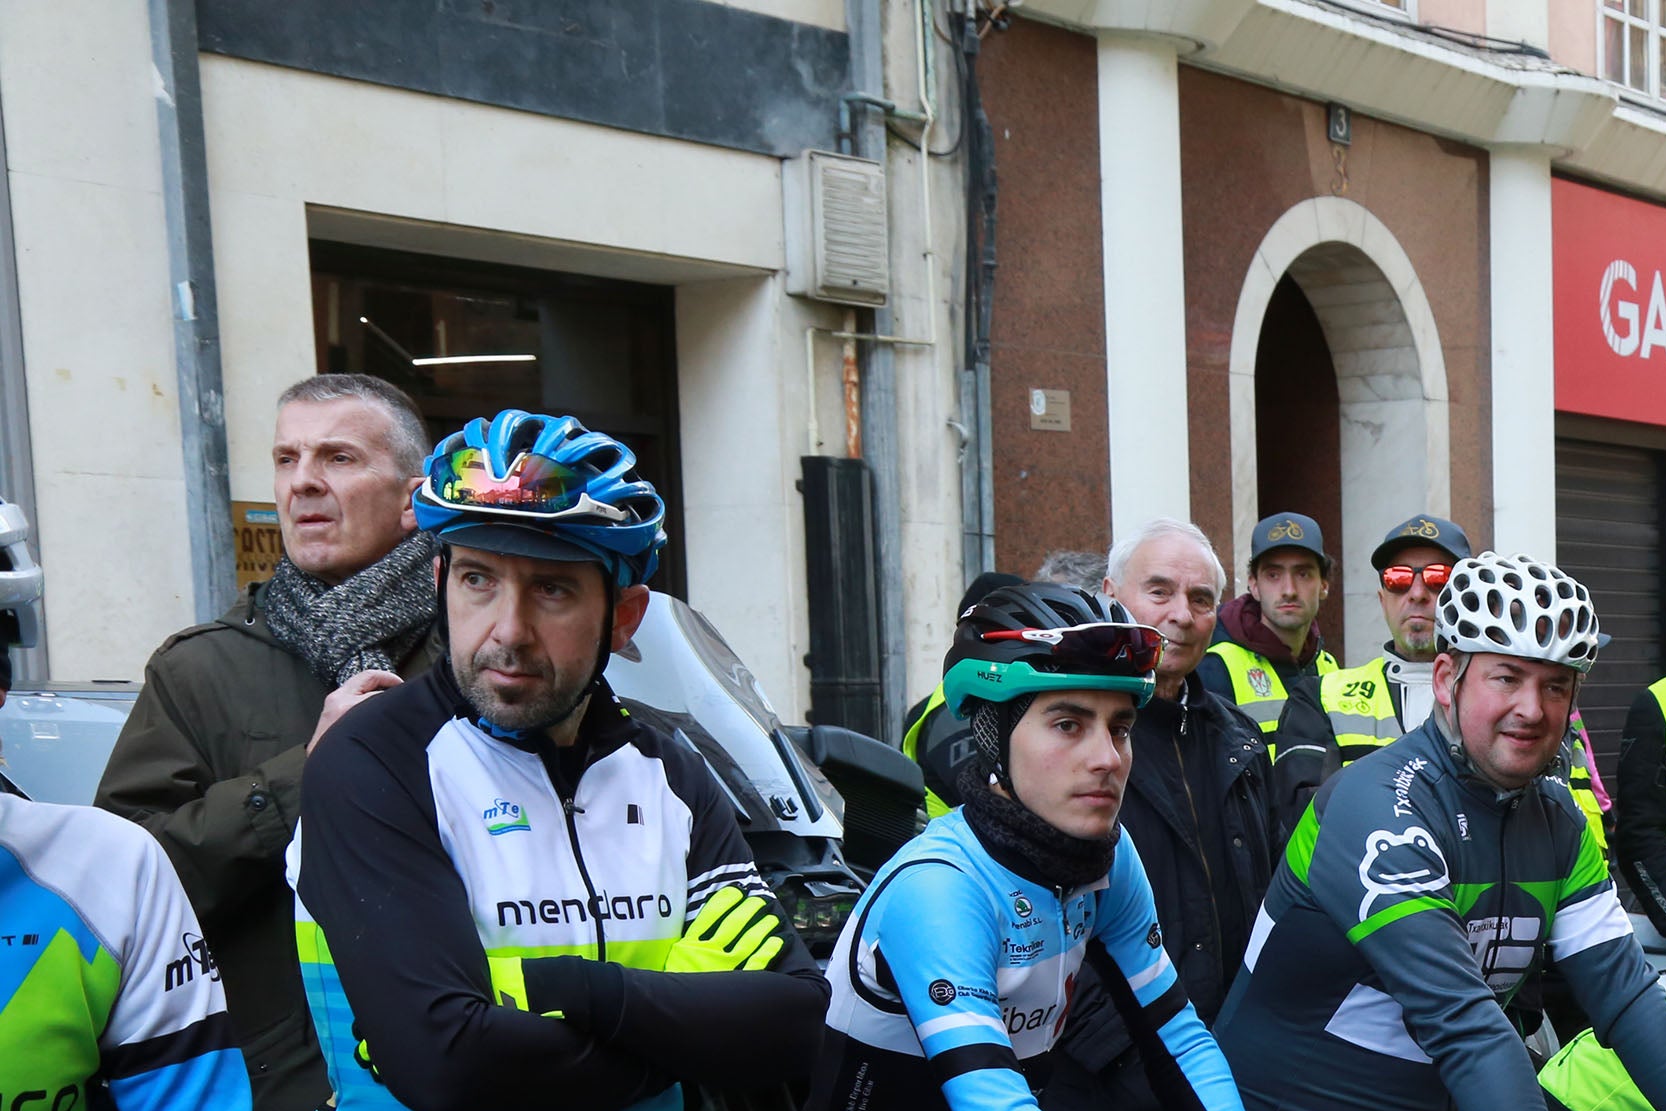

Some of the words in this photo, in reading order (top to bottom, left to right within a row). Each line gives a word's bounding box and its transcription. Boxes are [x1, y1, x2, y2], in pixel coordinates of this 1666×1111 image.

[1335, 108, 1346, 137] 3
[977, 671, 1002, 683] HUEZ
[1342, 680, 1376, 699] 29
[497, 888, 672, 927] mendaro
[998, 997, 1057, 1035] ibar
